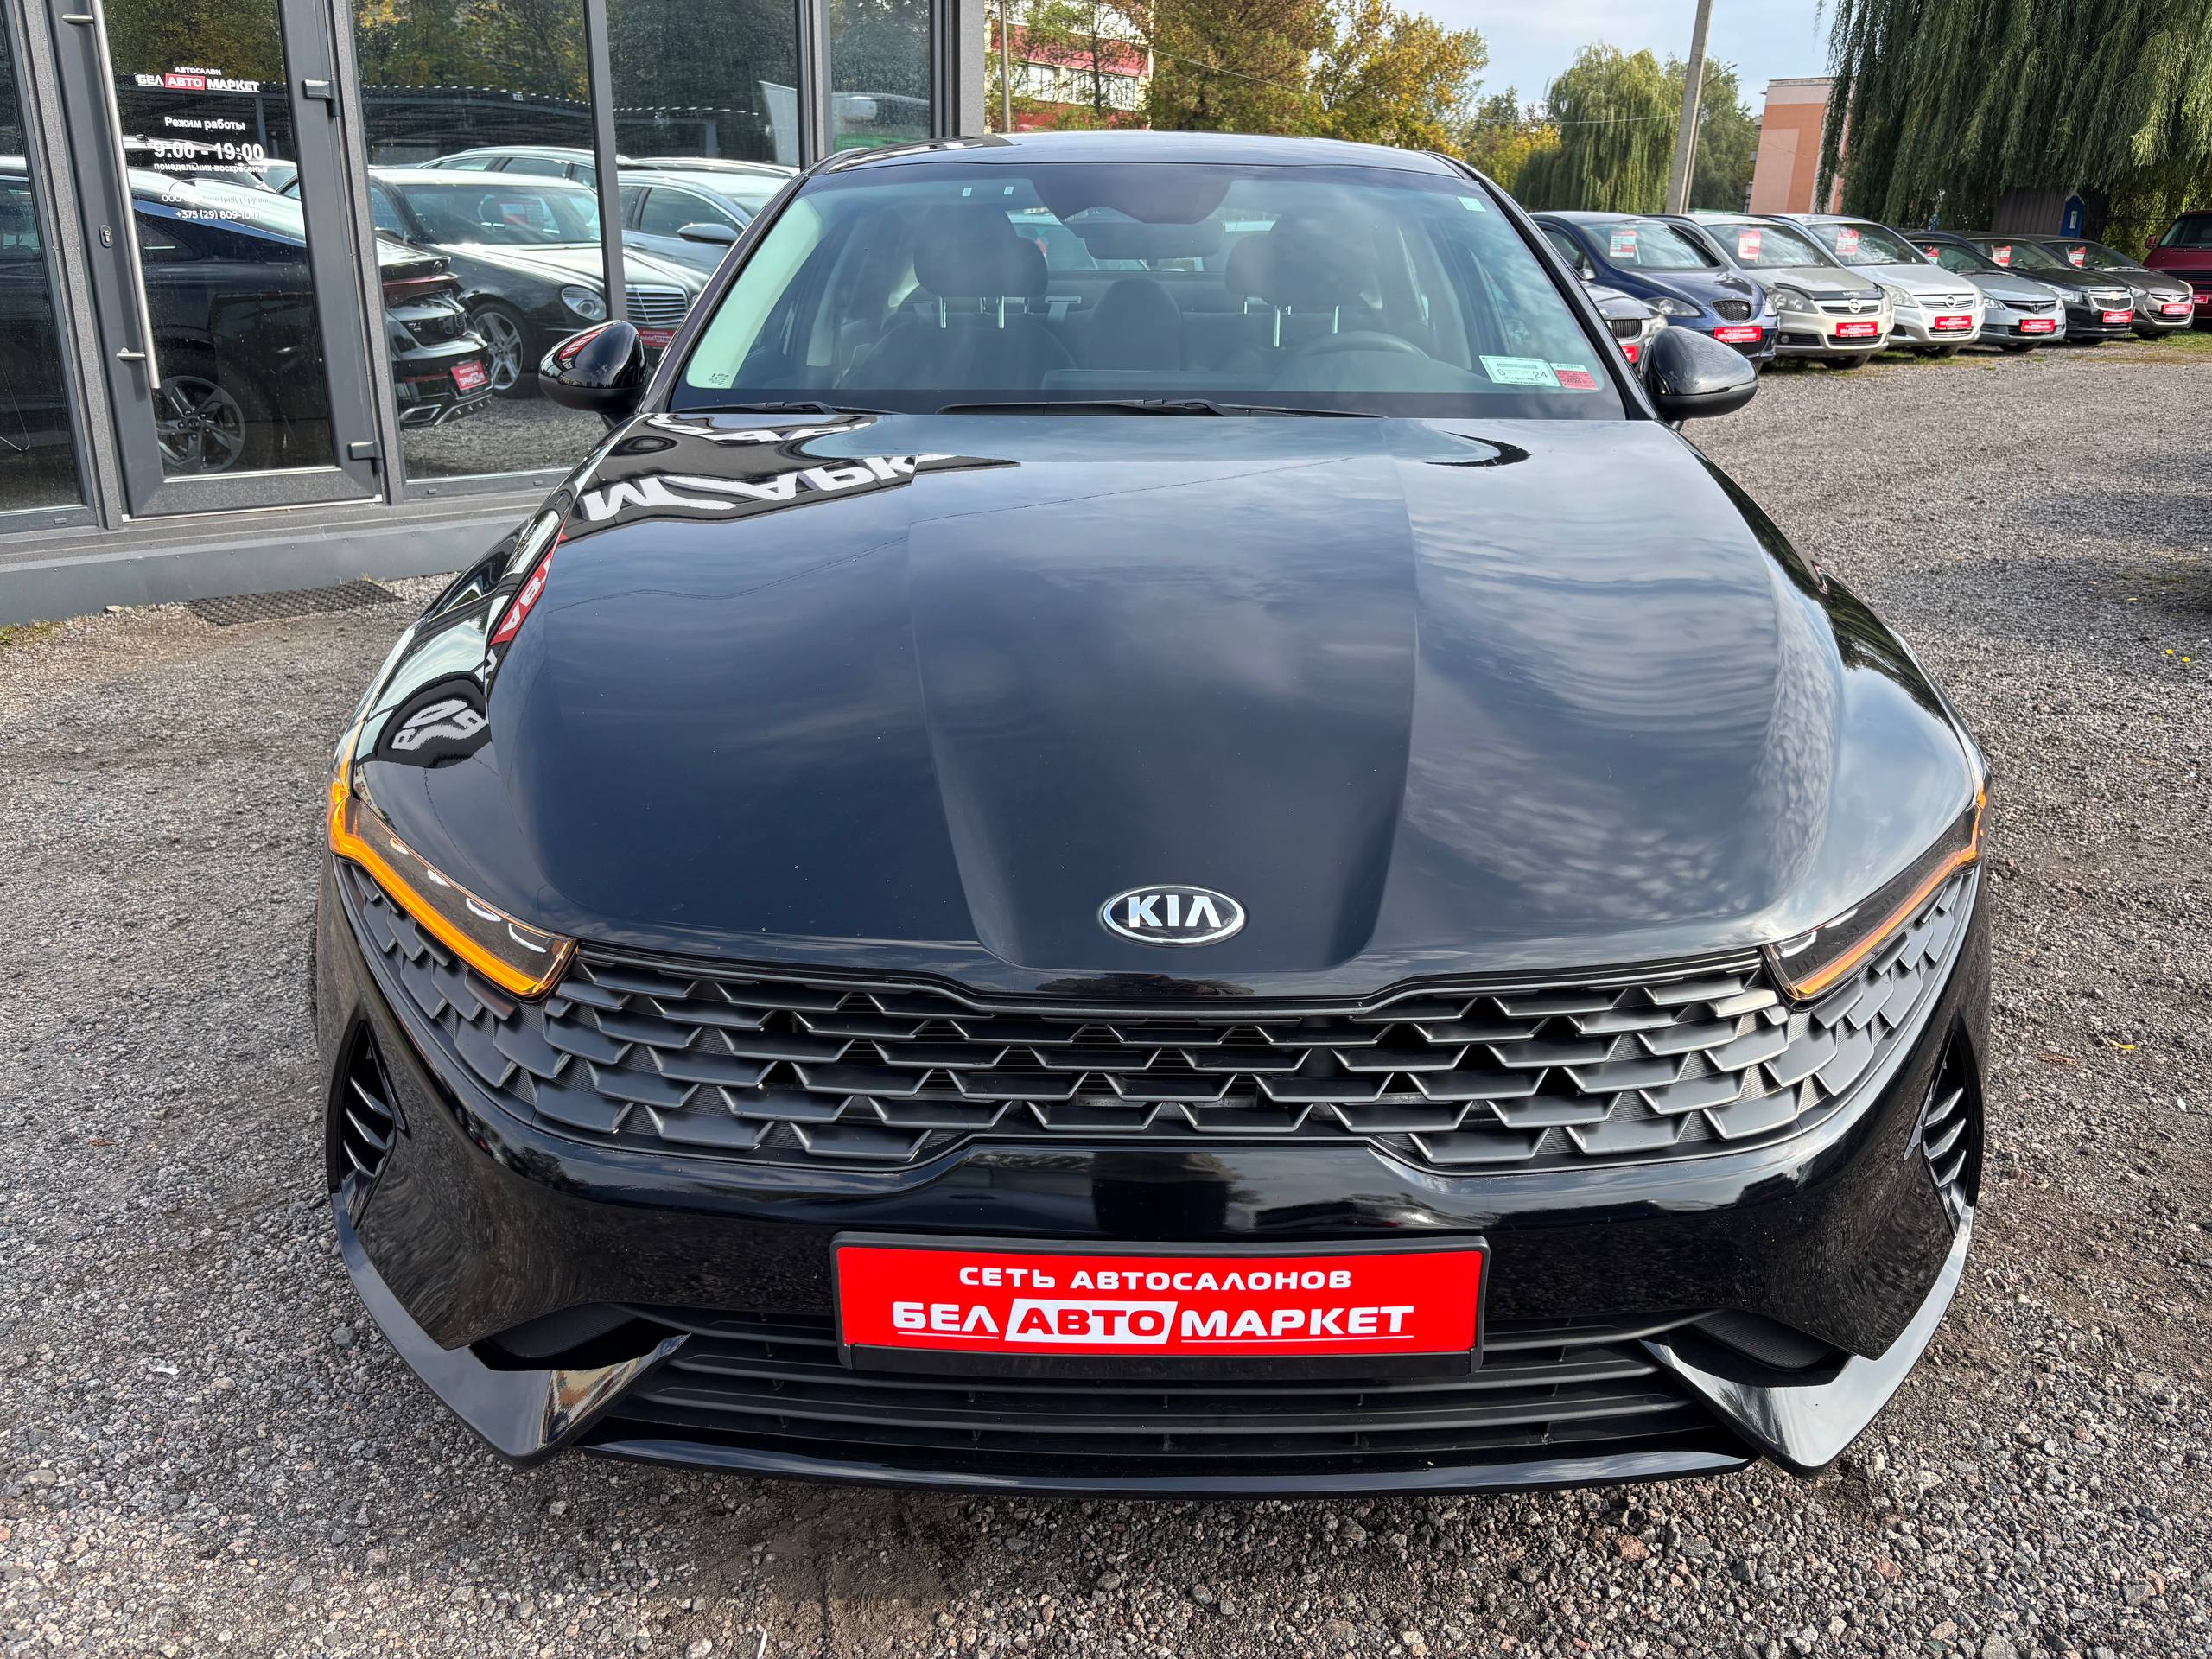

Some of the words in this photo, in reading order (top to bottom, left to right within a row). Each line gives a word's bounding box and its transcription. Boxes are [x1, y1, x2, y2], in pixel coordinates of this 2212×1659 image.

[175, 67, 221, 75] АВТОСАЛОН
[168, 77, 203, 88] АВТО
[207, 79, 260, 92] МАРКЕТ
[164, 117, 201, 128] Режим
[204, 118, 245, 130] работы
[154, 141, 195, 159] 9:00
[213, 142, 264, 161] 19:00
[175, 209, 199, 219] +375
[200, 209, 218, 219] (29)
[1127, 894, 1223, 928] KIA
[959, 1266, 1056, 1290] СЕТЬ
[1070, 1270, 1352, 1292] АВТОСАЛОНОВ
